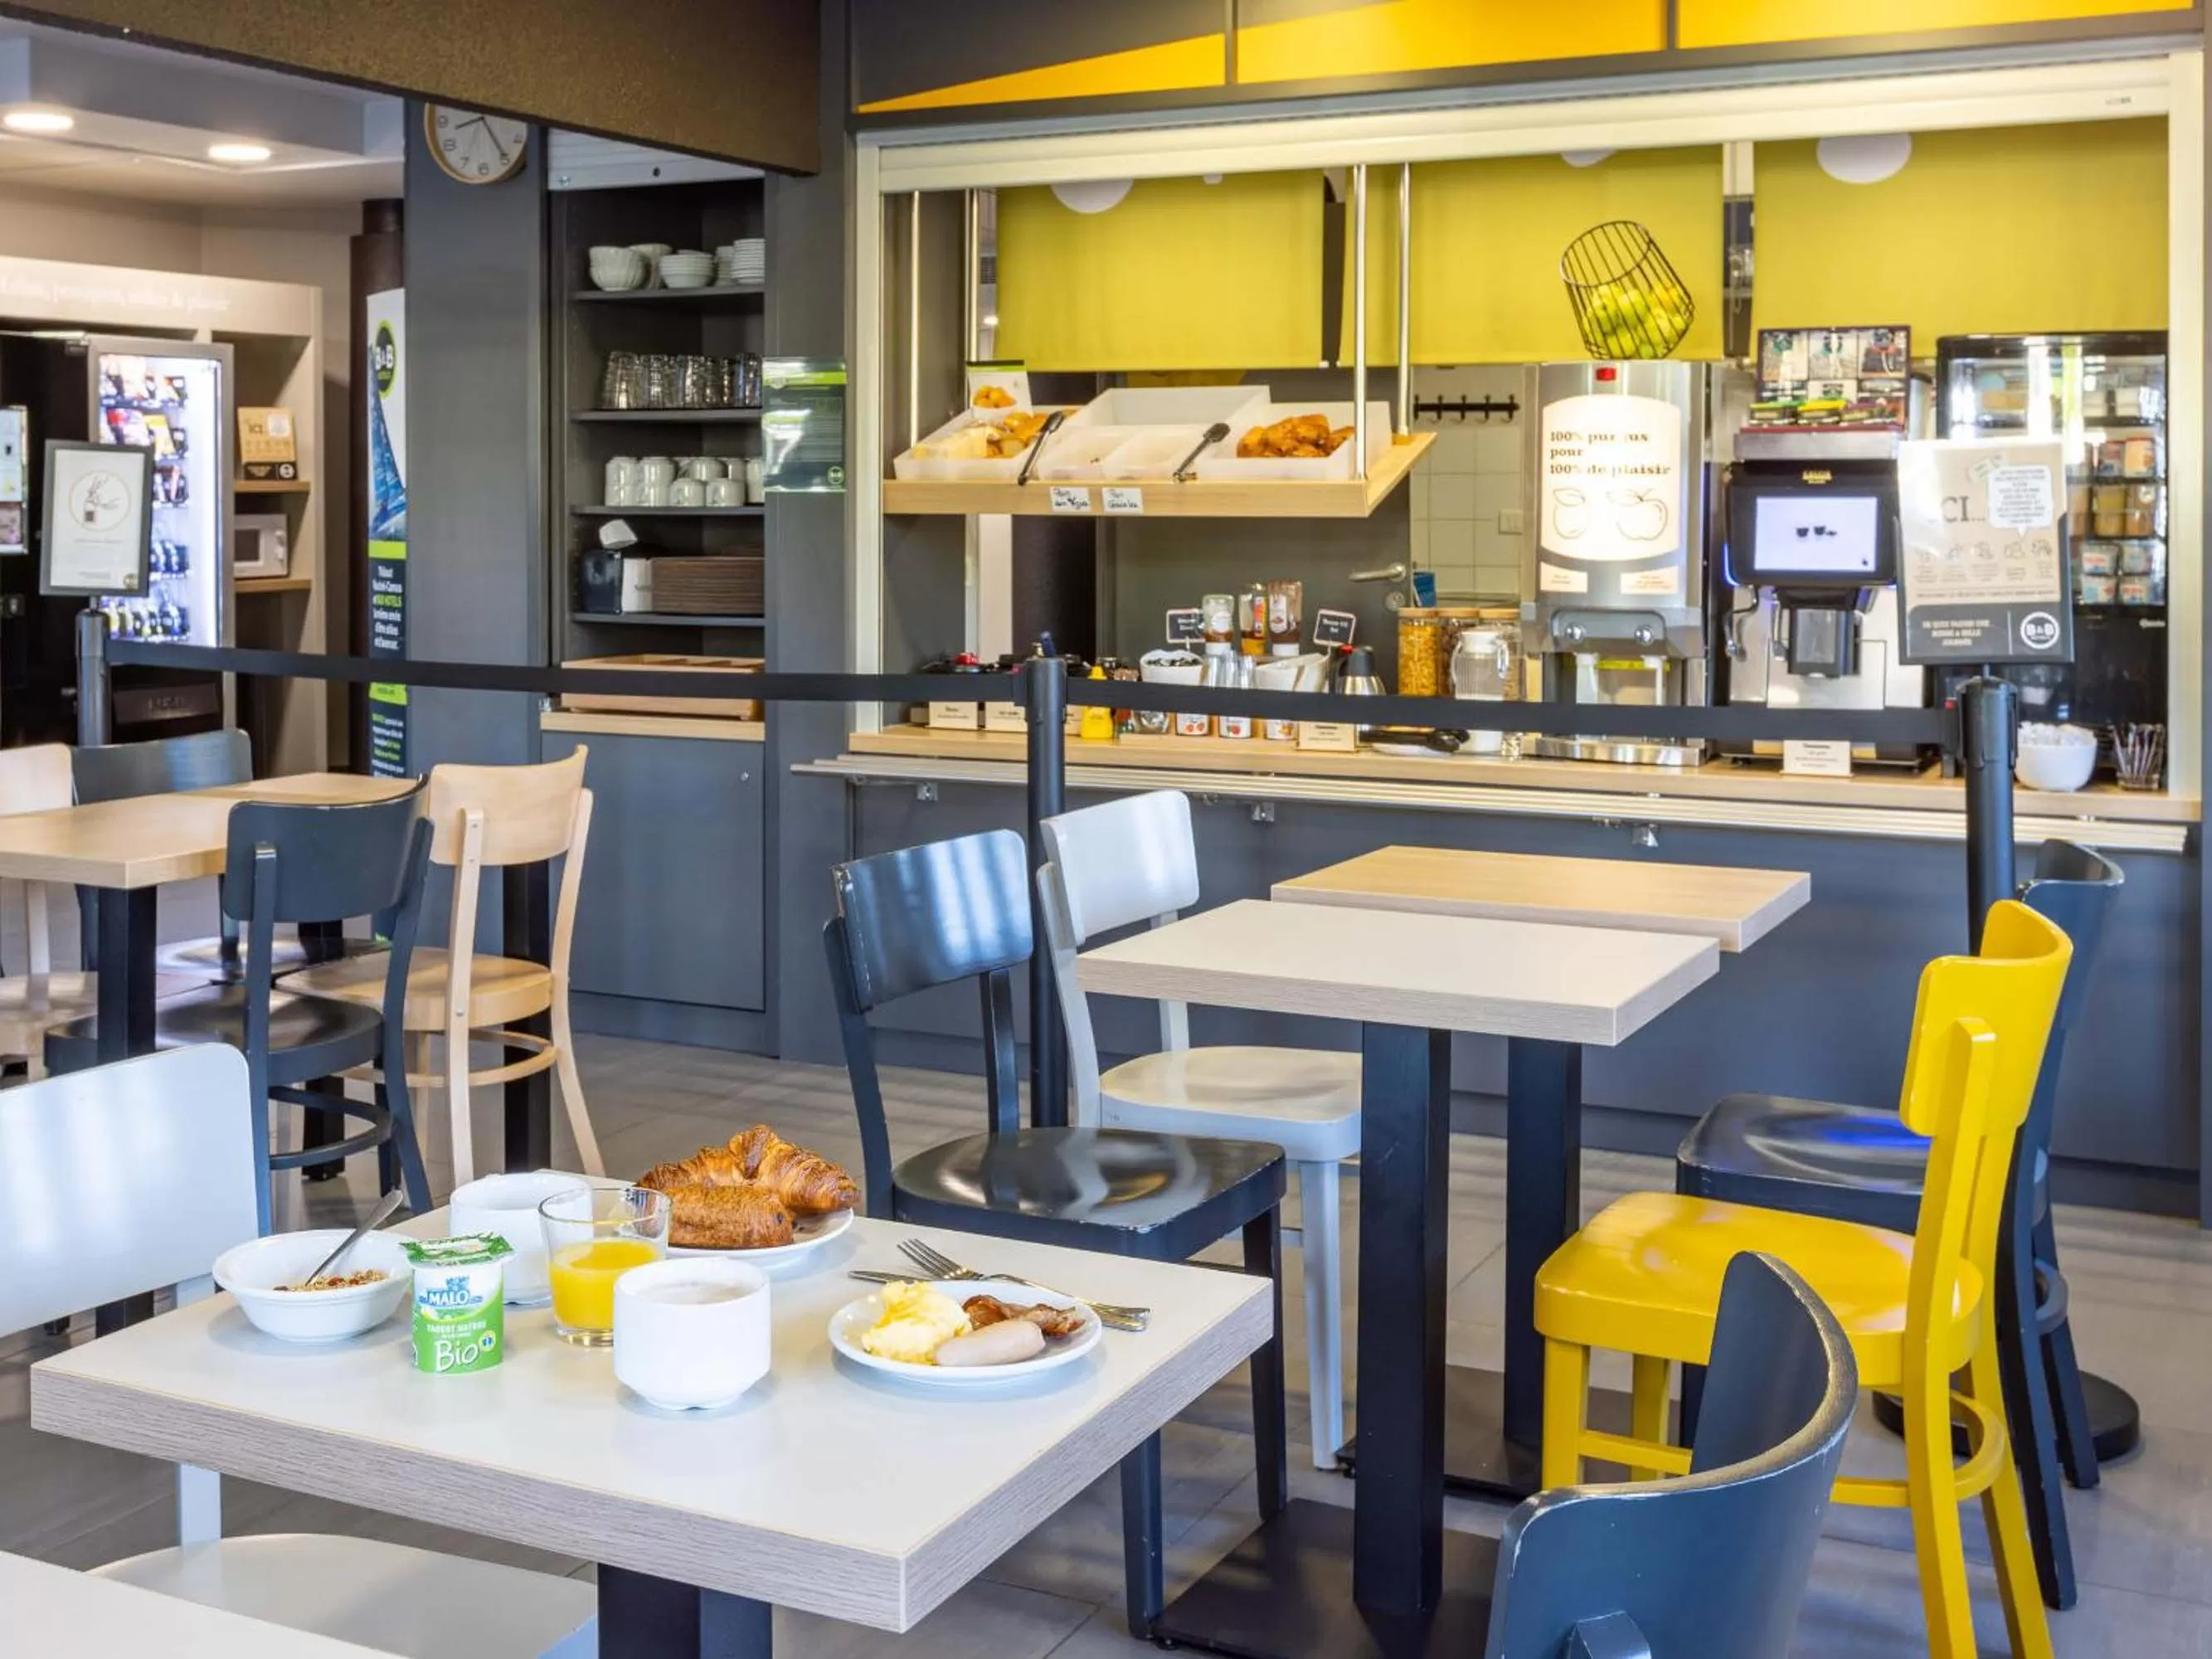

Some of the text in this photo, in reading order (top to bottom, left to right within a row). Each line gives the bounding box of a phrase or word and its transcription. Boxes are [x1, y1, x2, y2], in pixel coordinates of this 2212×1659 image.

[1624, 432, 1650, 443] us
[1549, 446, 1584, 460] pour
[2025, 623, 2054, 636] B&B
[429, 1289, 469, 1306] MALO
[435, 1339, 479, 1373] Bio
